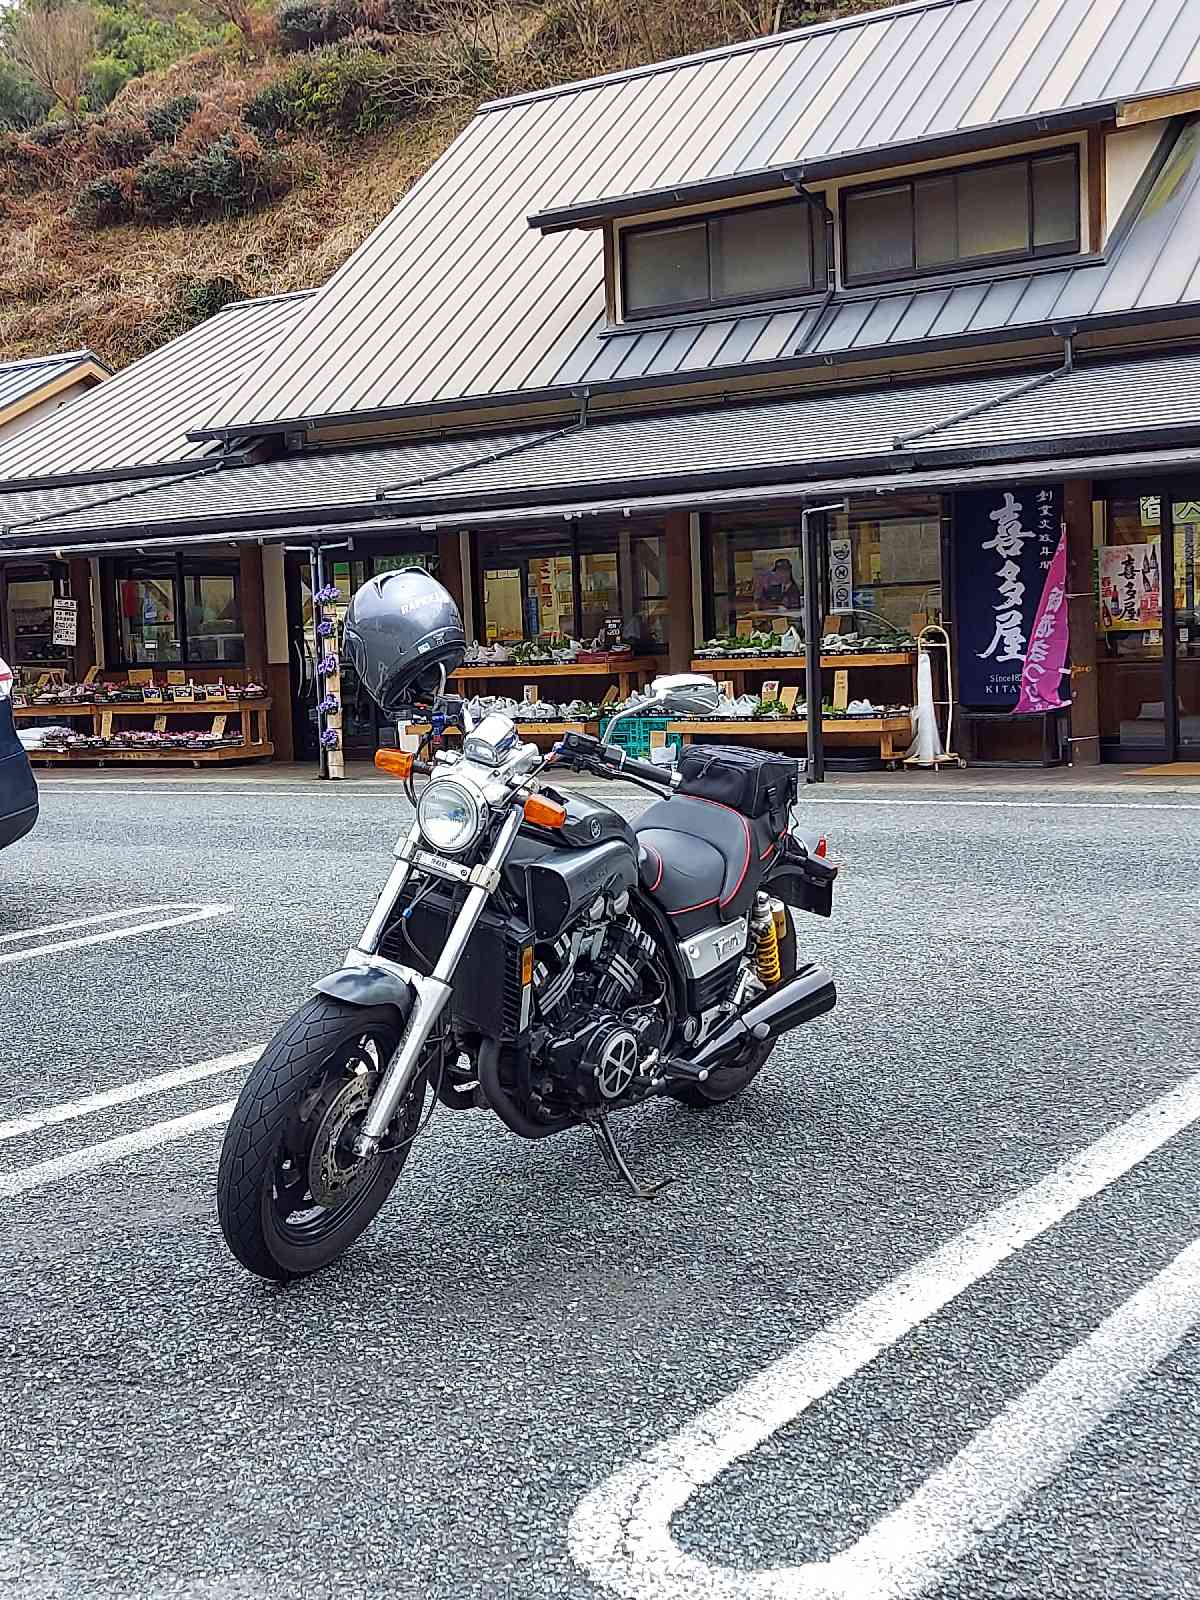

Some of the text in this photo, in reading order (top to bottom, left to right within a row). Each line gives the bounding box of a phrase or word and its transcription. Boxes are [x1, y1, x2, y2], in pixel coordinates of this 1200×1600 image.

[976, 492, 1037, 662] 喜多屋
[1118, 553, 1141, 621] 喜多屋
[985, 685, 1022, 694] KITA
